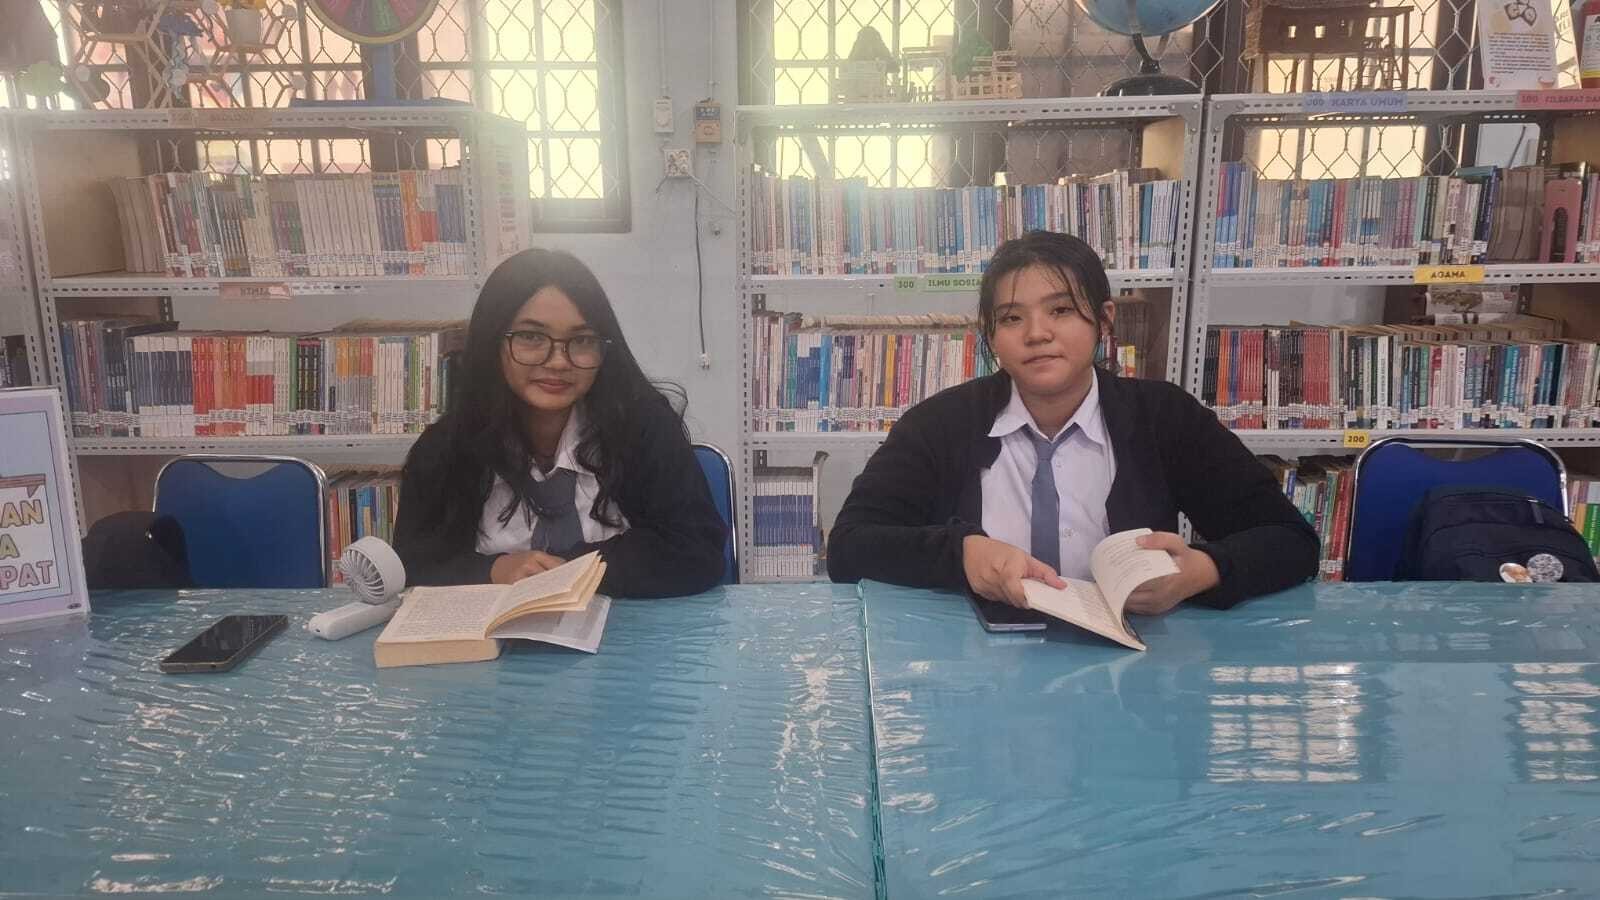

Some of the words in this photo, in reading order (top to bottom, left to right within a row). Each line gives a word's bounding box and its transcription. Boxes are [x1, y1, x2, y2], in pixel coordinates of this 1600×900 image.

[1331, 98, 1368, 107] KARYA
[1370, 97, 1403, 106] UMUM
[1430, 270, 1466, 279] AGAMA
[927, 279, 951, 288] ILMU
